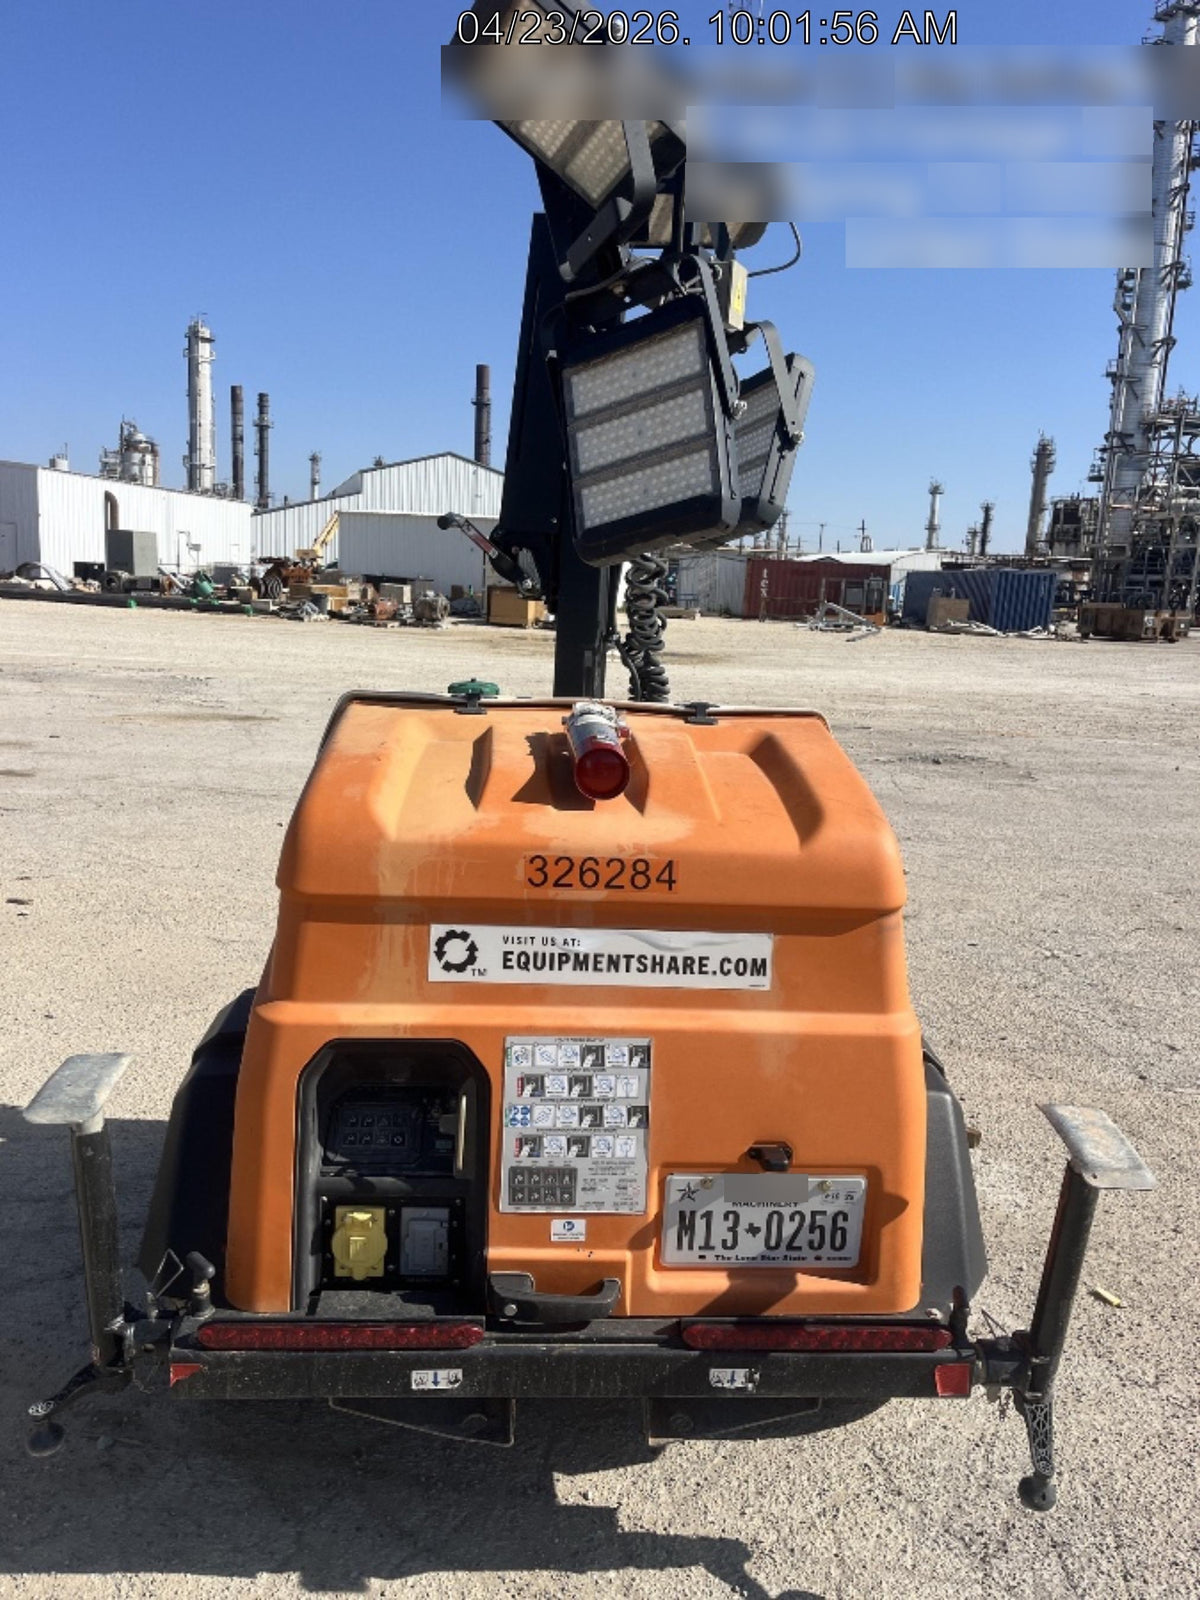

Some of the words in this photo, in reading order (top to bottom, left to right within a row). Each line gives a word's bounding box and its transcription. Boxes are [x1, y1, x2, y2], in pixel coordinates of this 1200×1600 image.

[527, 854, 677, 891] 326284
[502, 934, 536, 945] VISIT
[541, 936, 557, 947] US
[562, 938, 581, 947] AT:
[471, 968, 488, 977] TM
[502, 950, 767, 977] EQUIPMENTSHARE.COM
